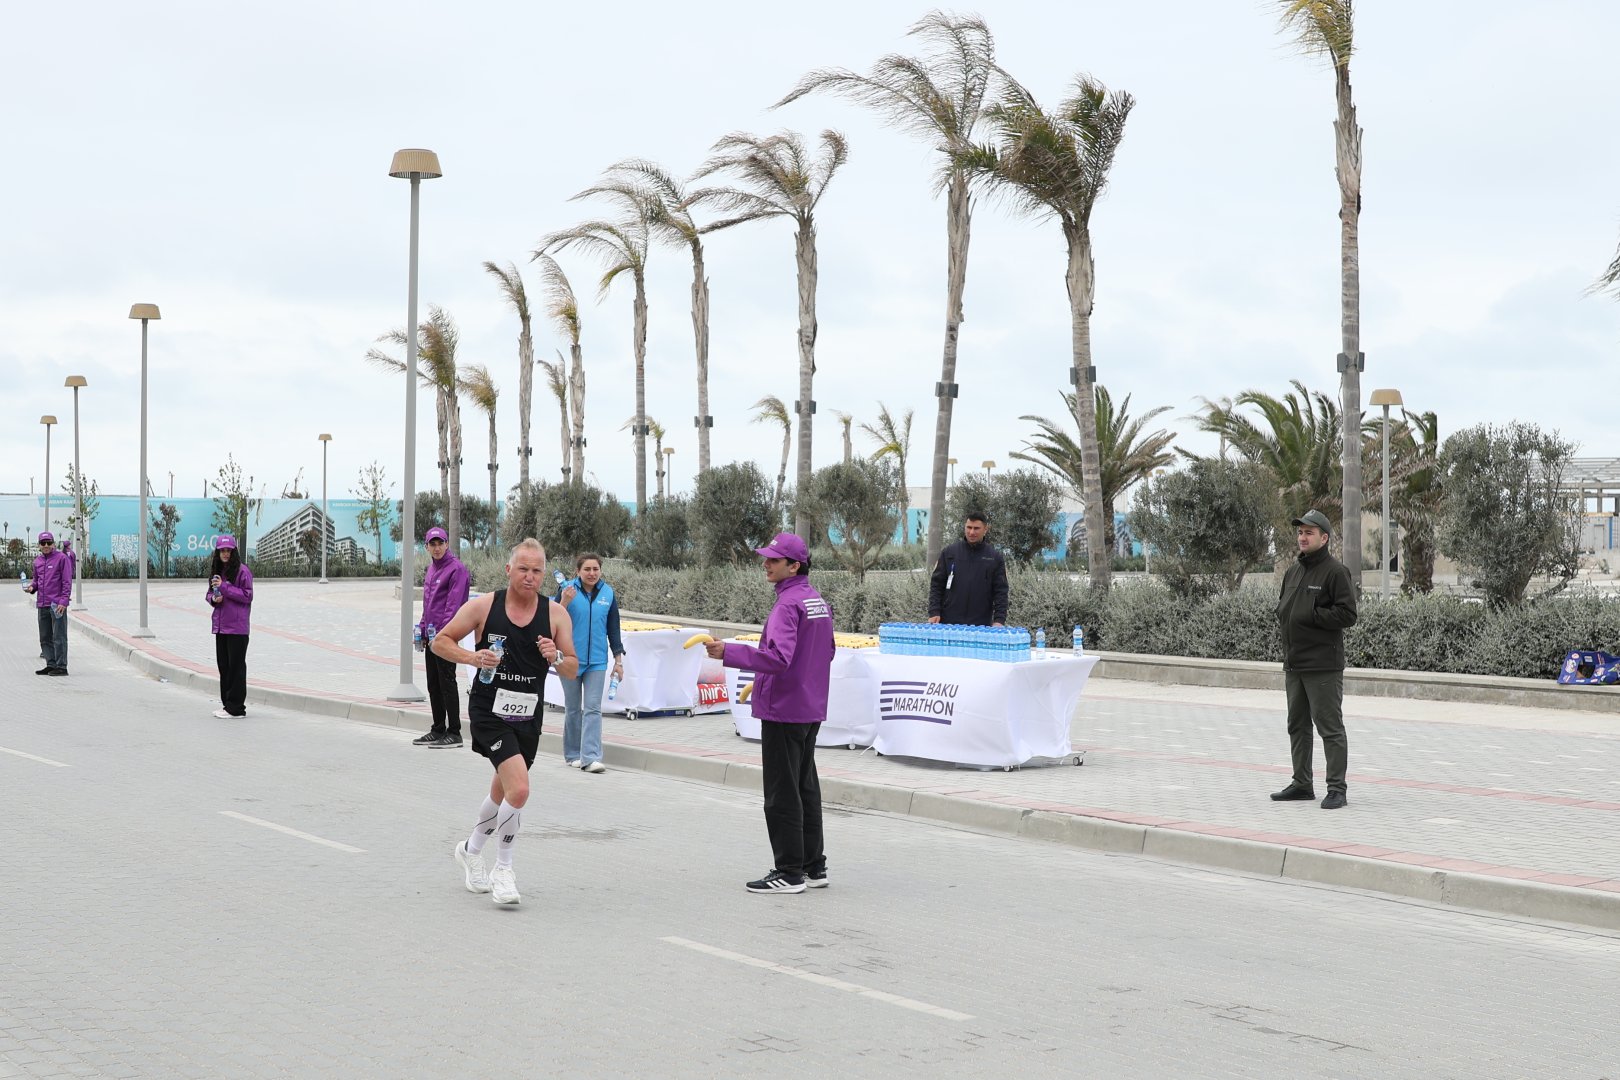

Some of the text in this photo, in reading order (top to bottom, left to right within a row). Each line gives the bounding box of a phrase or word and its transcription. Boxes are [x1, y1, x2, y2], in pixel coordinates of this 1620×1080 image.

[187, 534, 239, 551] 840
[499, 672, 537, 684] BURNT
[926, 682, 959, 698] BAKU
[502, 703, 528, 714] 4921
[893, 697, 954, 716] MARATHON
